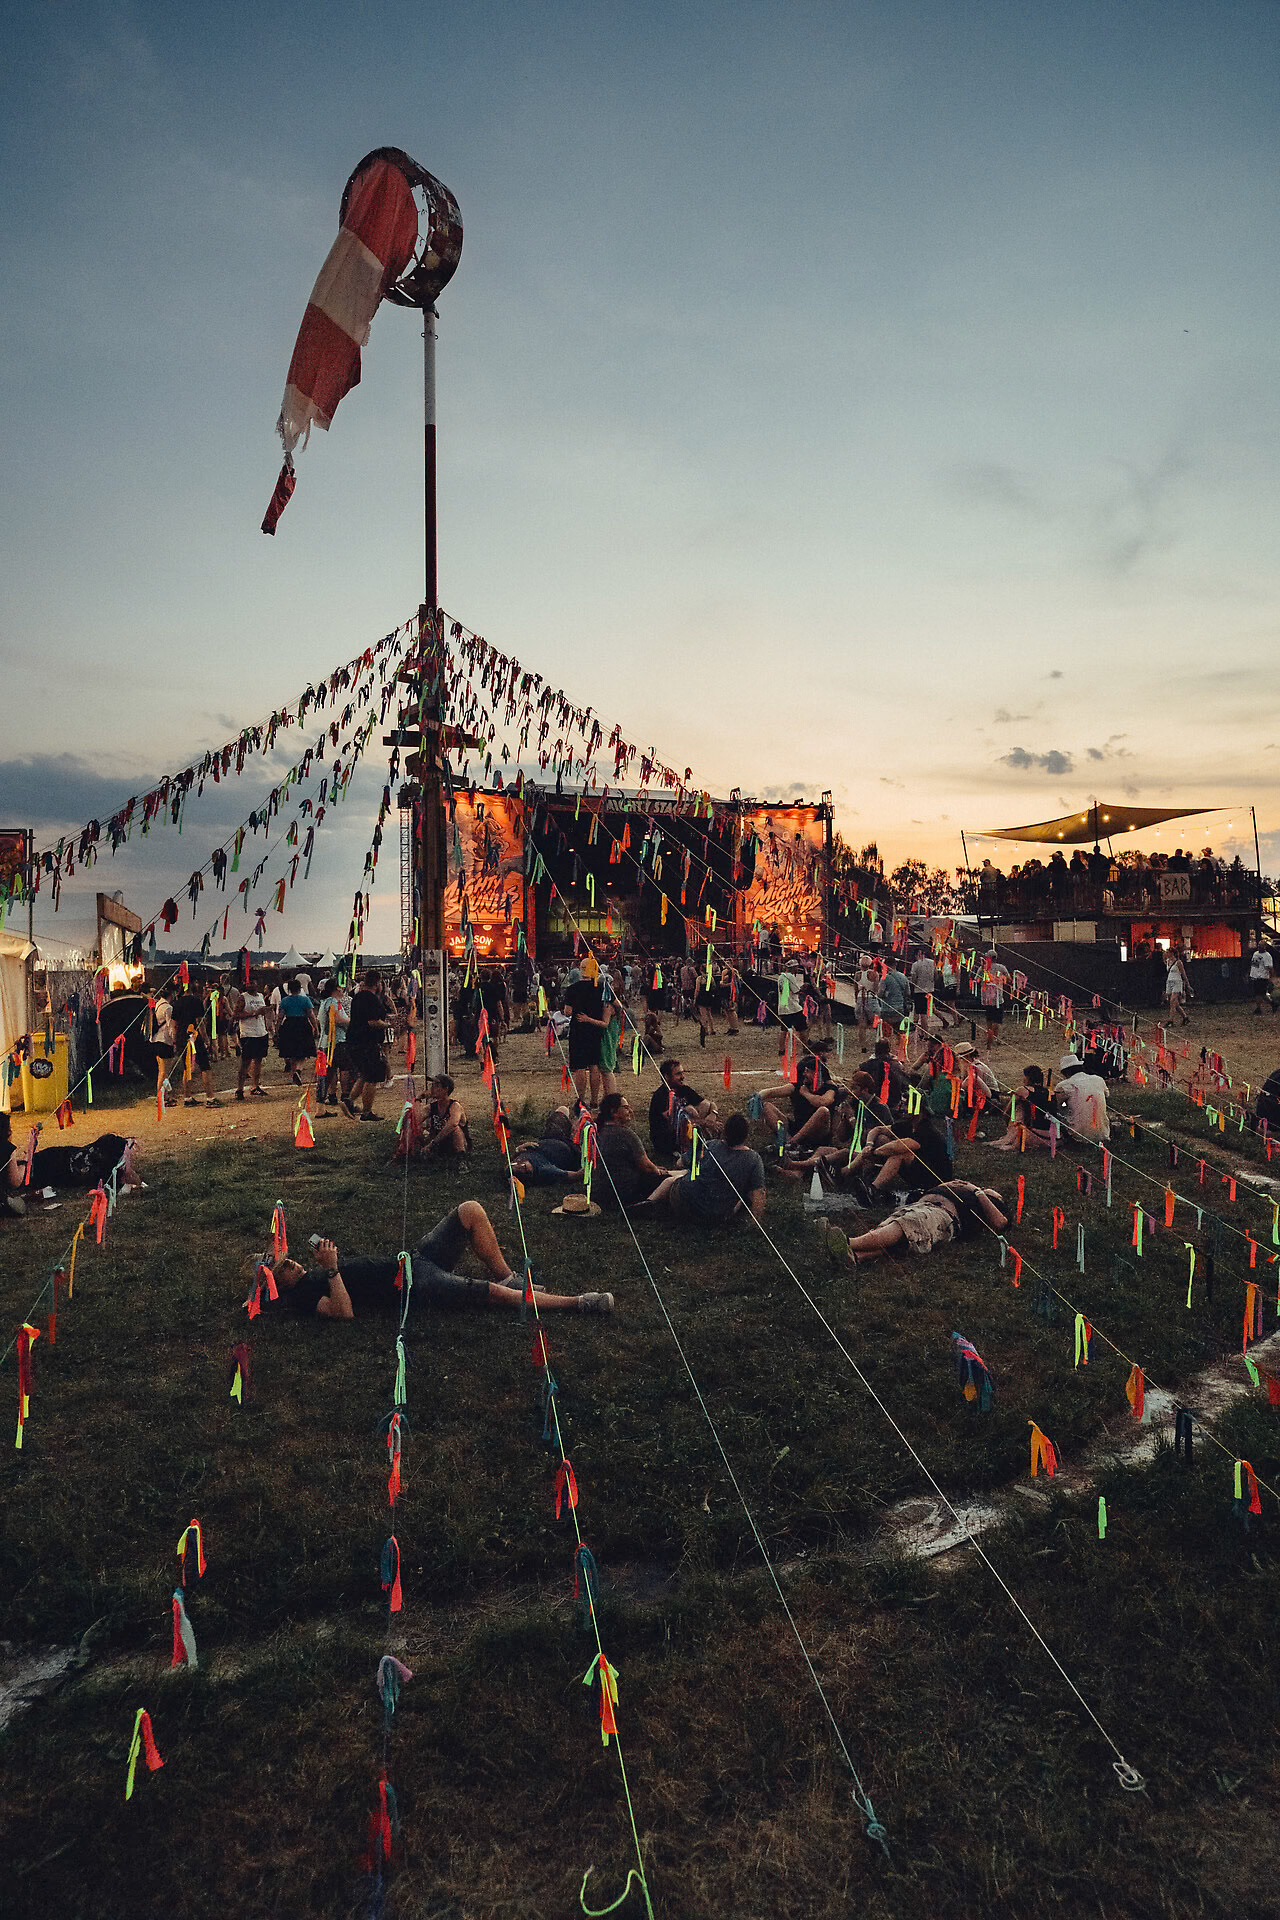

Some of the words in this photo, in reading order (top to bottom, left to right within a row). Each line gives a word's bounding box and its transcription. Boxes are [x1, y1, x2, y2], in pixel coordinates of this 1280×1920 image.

[653, 800, 691, 816] STAGE
[752, 880, 809, 907] MIGHTY
[1163, 876, 1189, 896] BAR
[449, 934, 493, 947] JAMSON
